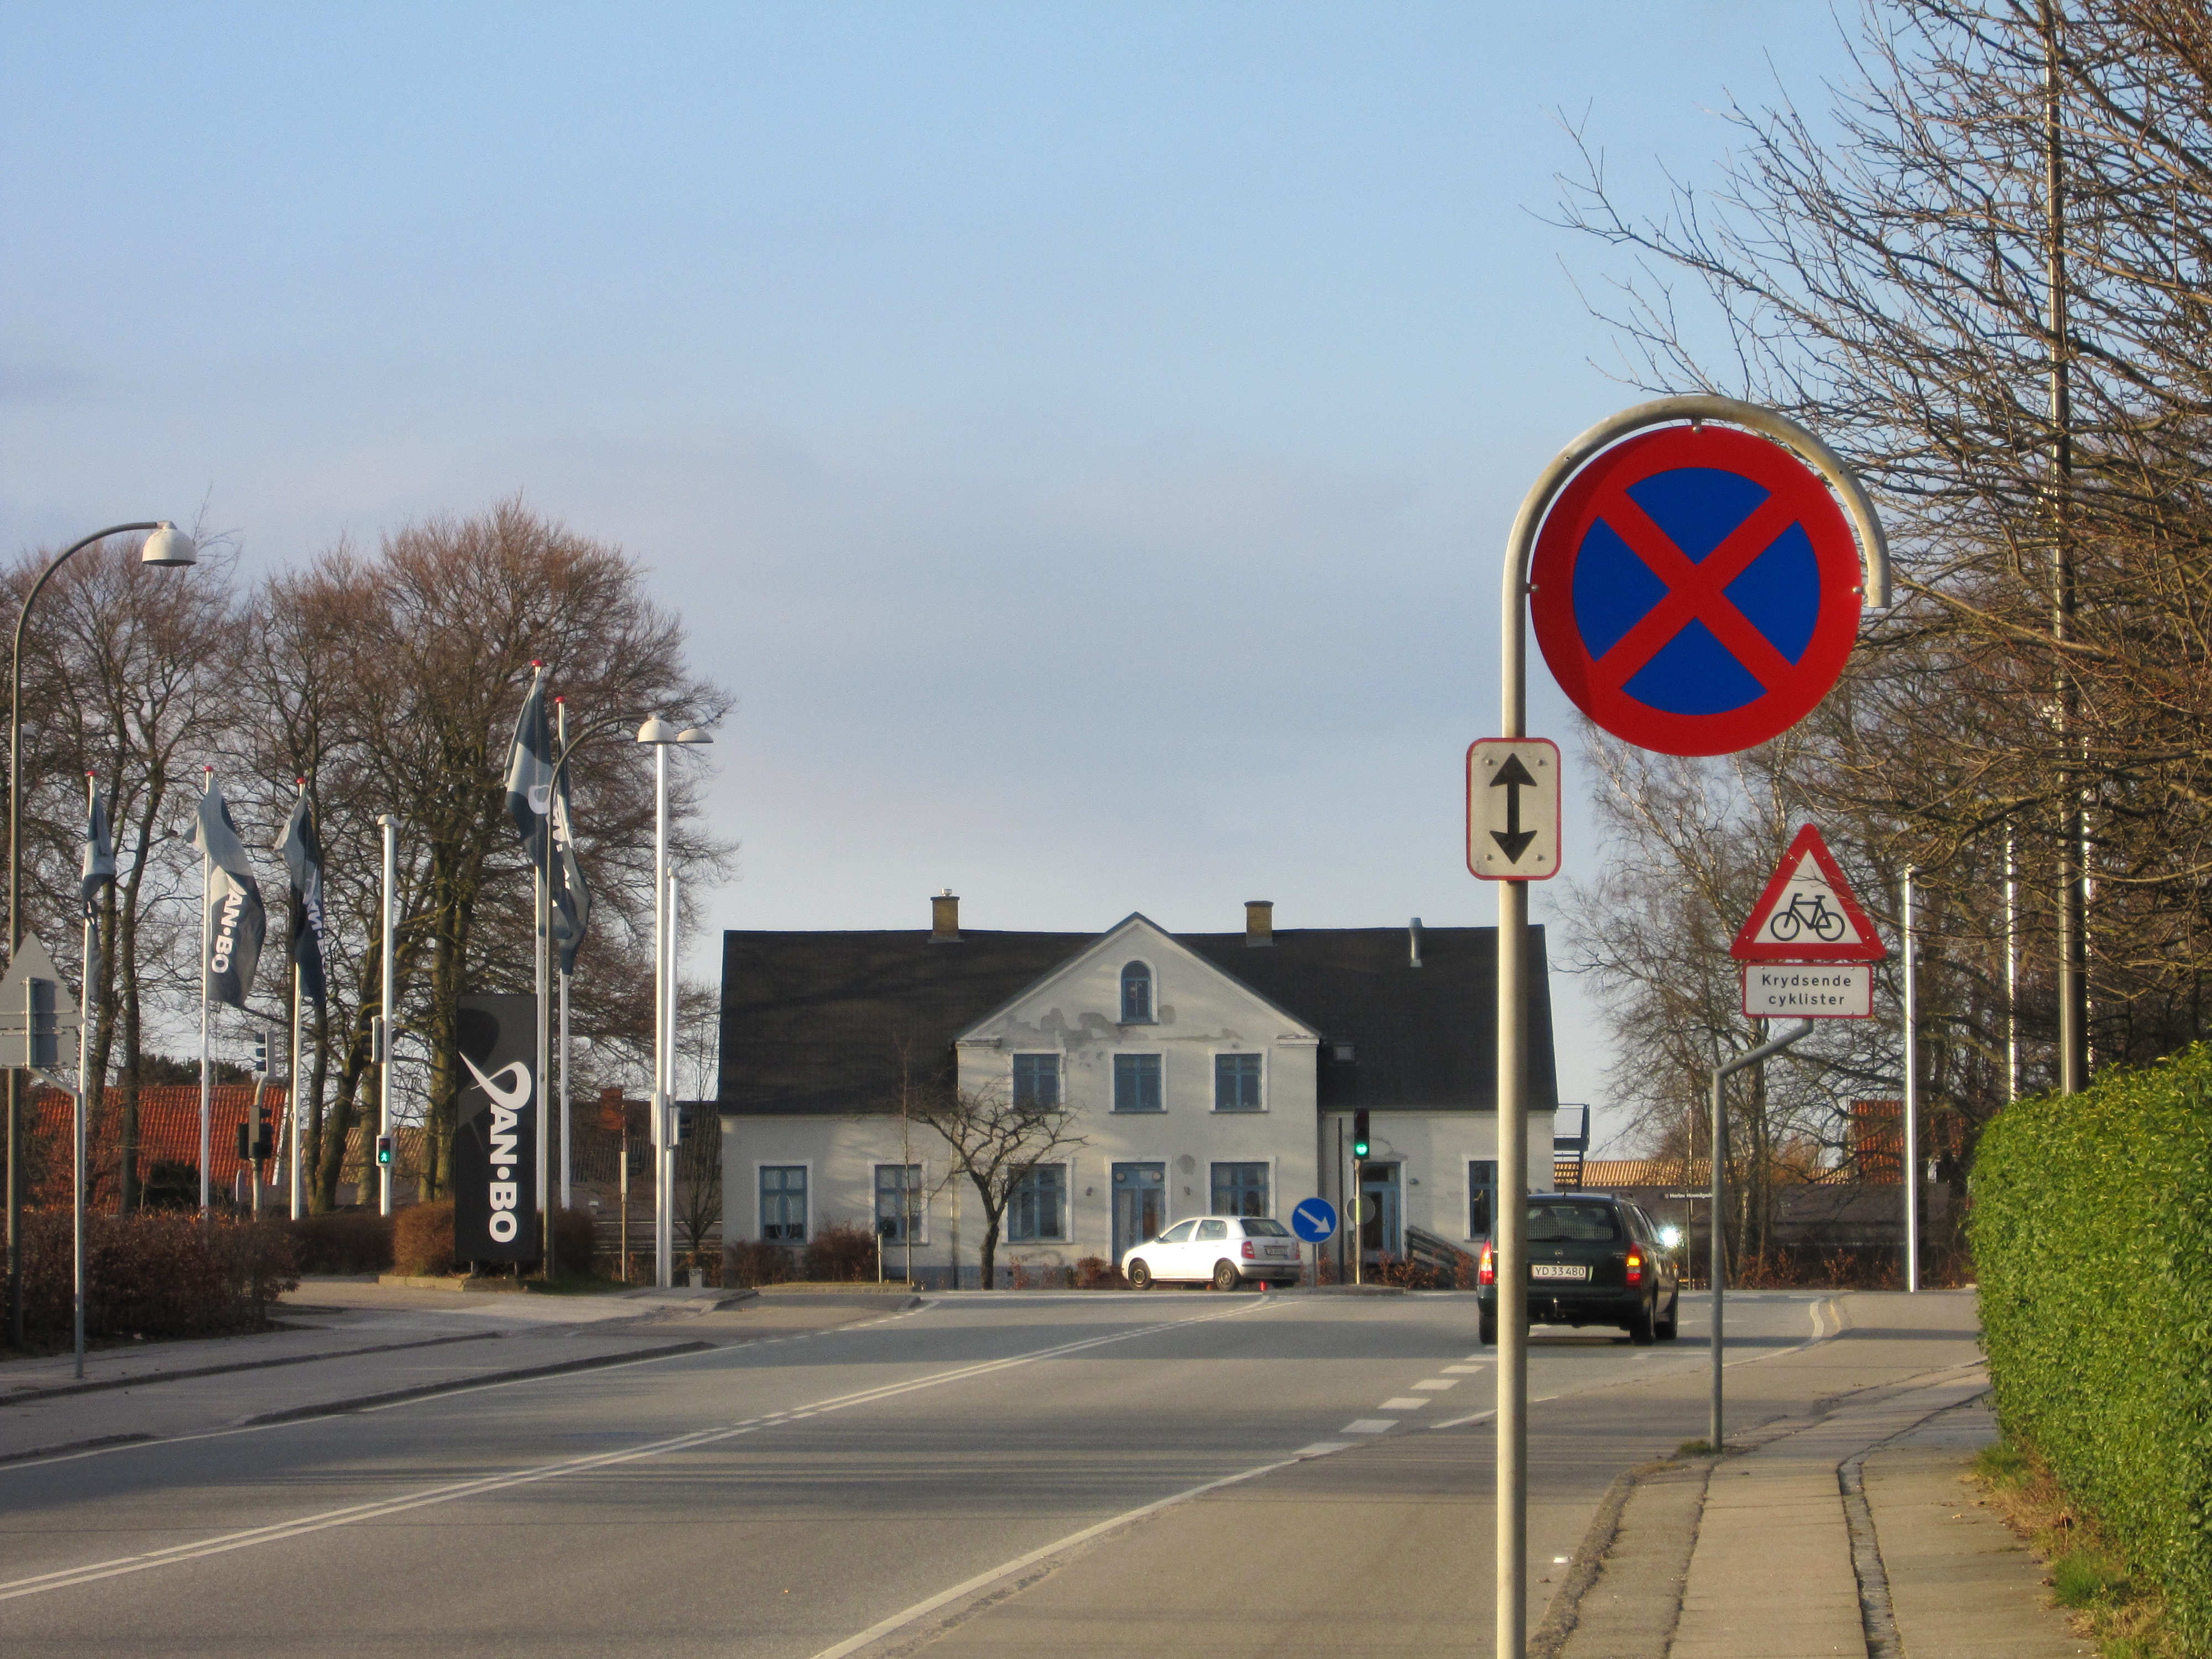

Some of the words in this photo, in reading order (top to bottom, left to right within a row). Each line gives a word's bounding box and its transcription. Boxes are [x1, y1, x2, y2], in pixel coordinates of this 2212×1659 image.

[1761, 974, 1852, 989] Krydsende
[1768, 993, 1845, 1007] cyklister
[1535, 1266, 1549, 1276] YD
[1551, 1266, 1563, 1276] 33
[1566, 1266, 1584, 1276] 480
